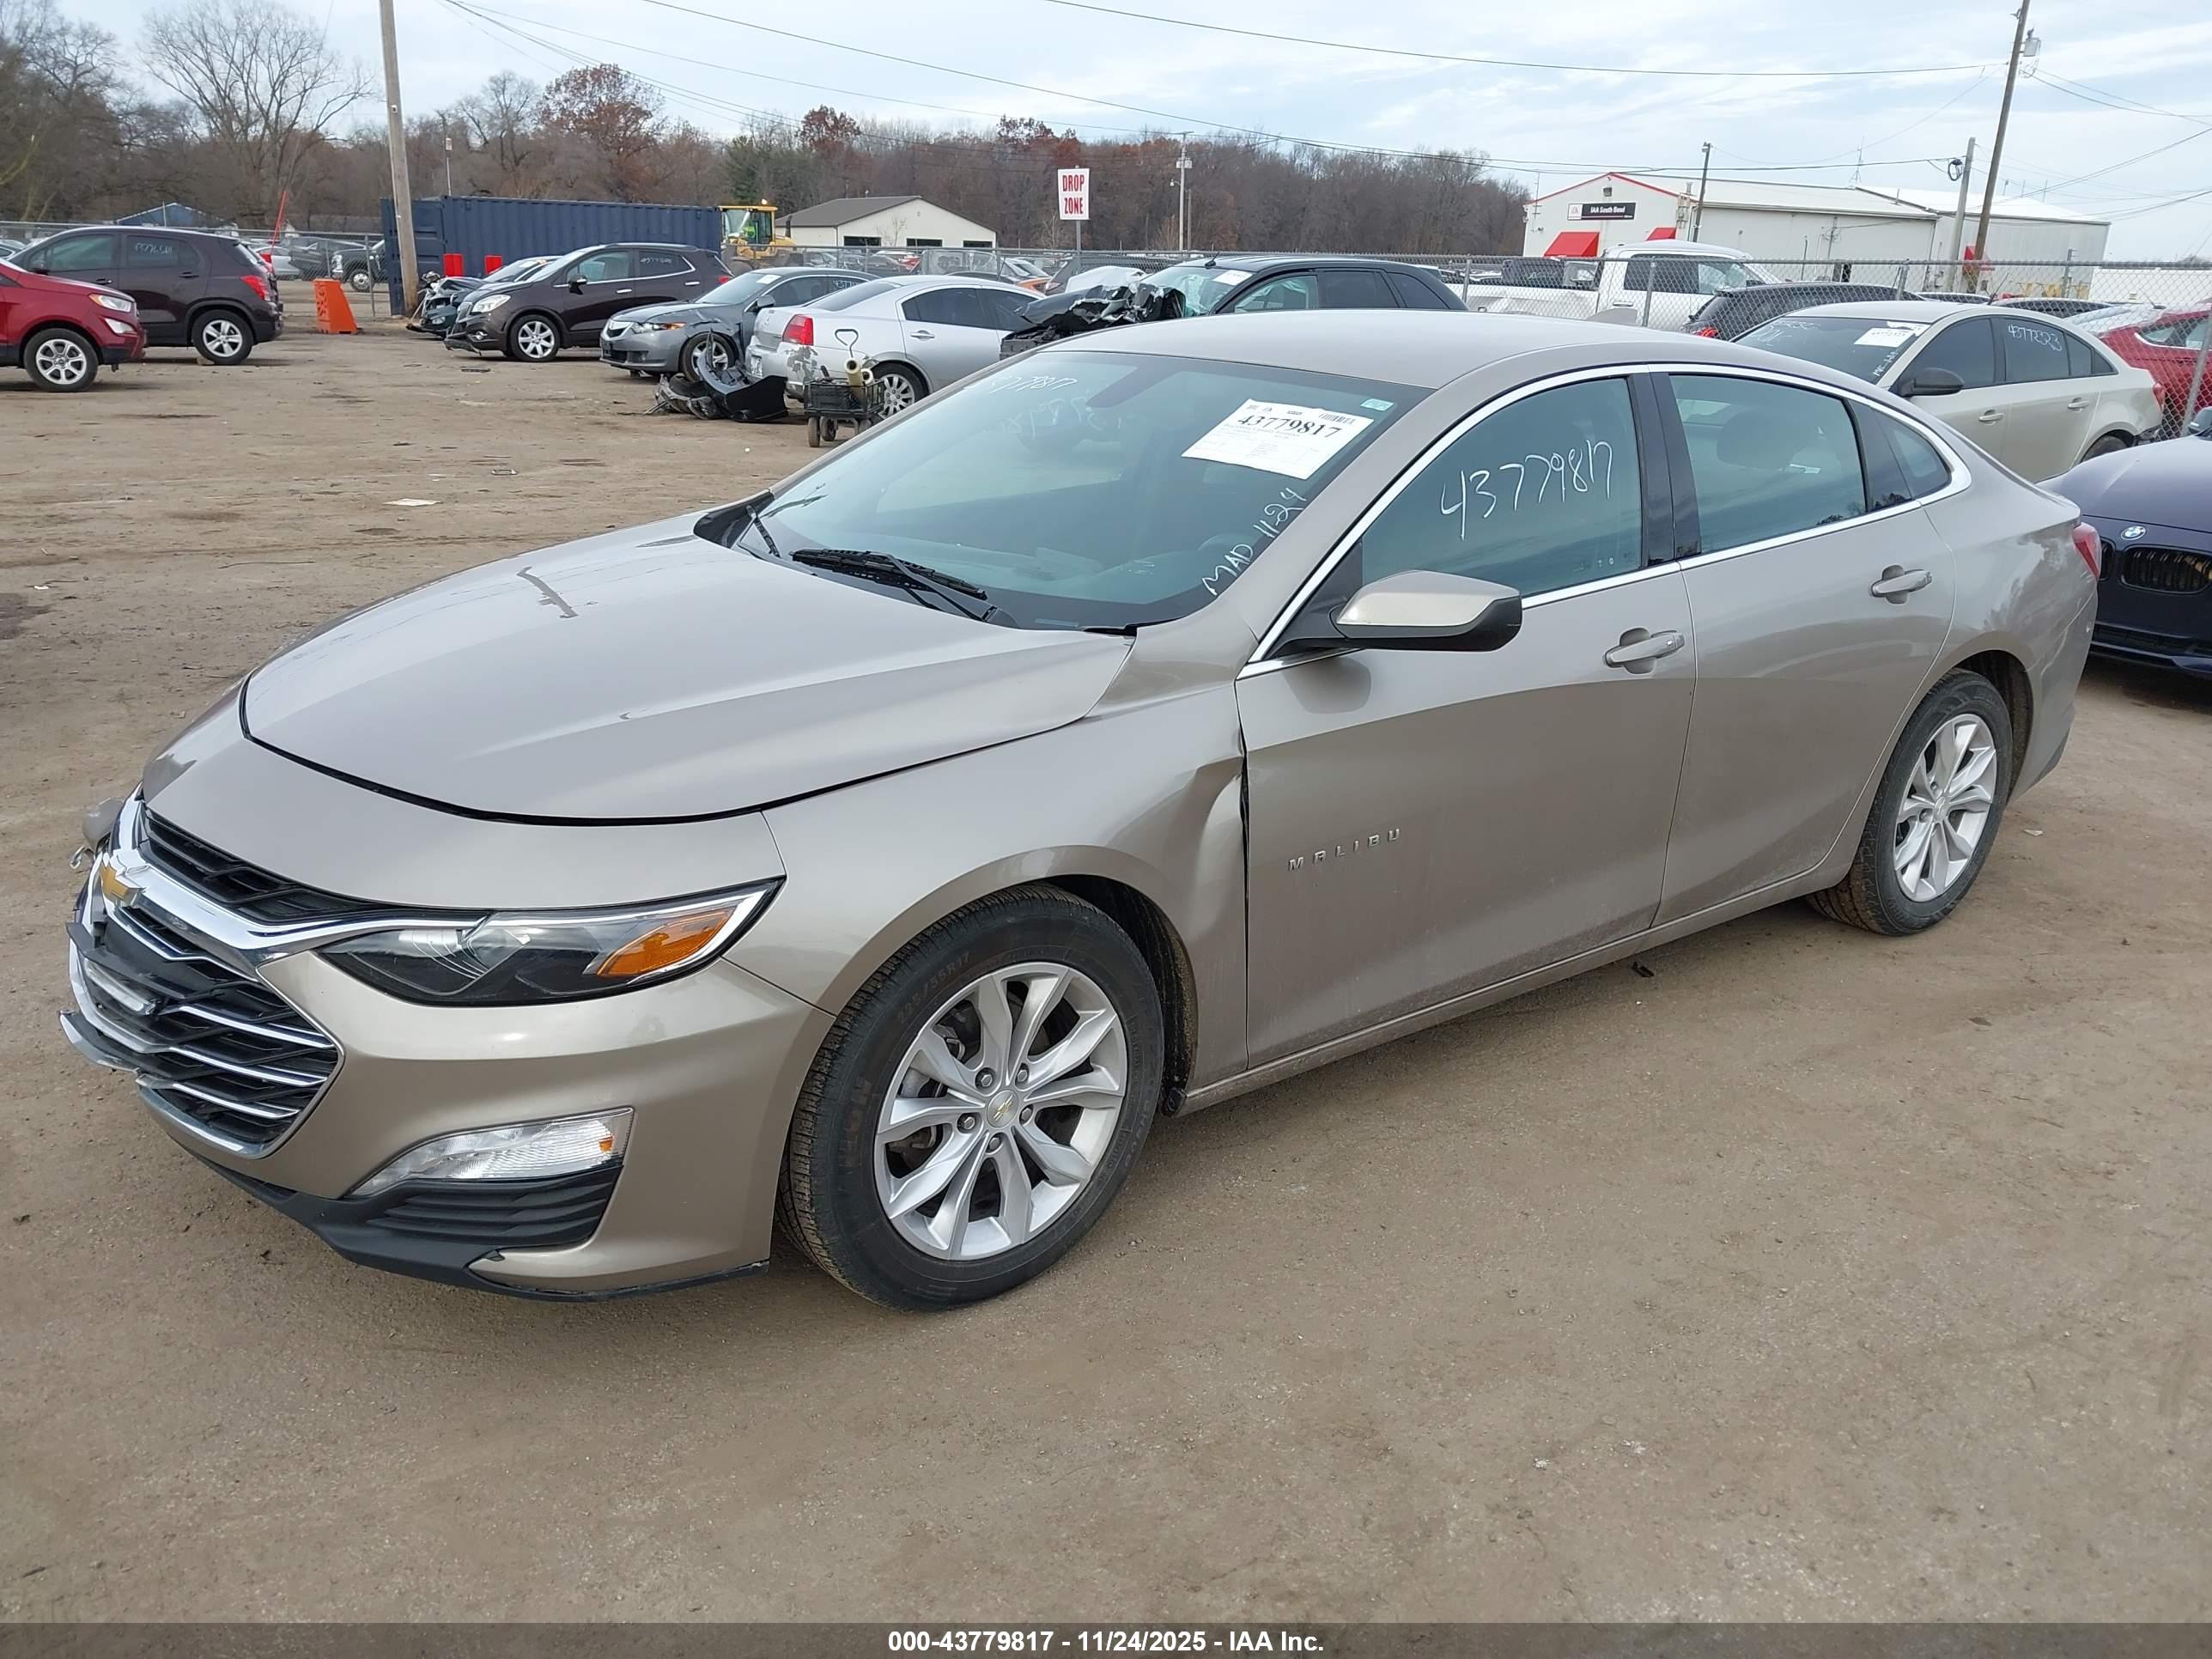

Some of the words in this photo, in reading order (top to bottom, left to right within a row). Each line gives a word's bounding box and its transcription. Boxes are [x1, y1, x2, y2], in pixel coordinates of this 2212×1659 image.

[1062, 174, 1085, 192] DROP
[1064, 197, 1085, 215] ZONE
[1237, 414, 1343, 439] 43779817
[1439, 439, 1613, 542] 43779817
[1288, 828, 1401, 872] MALIBU
